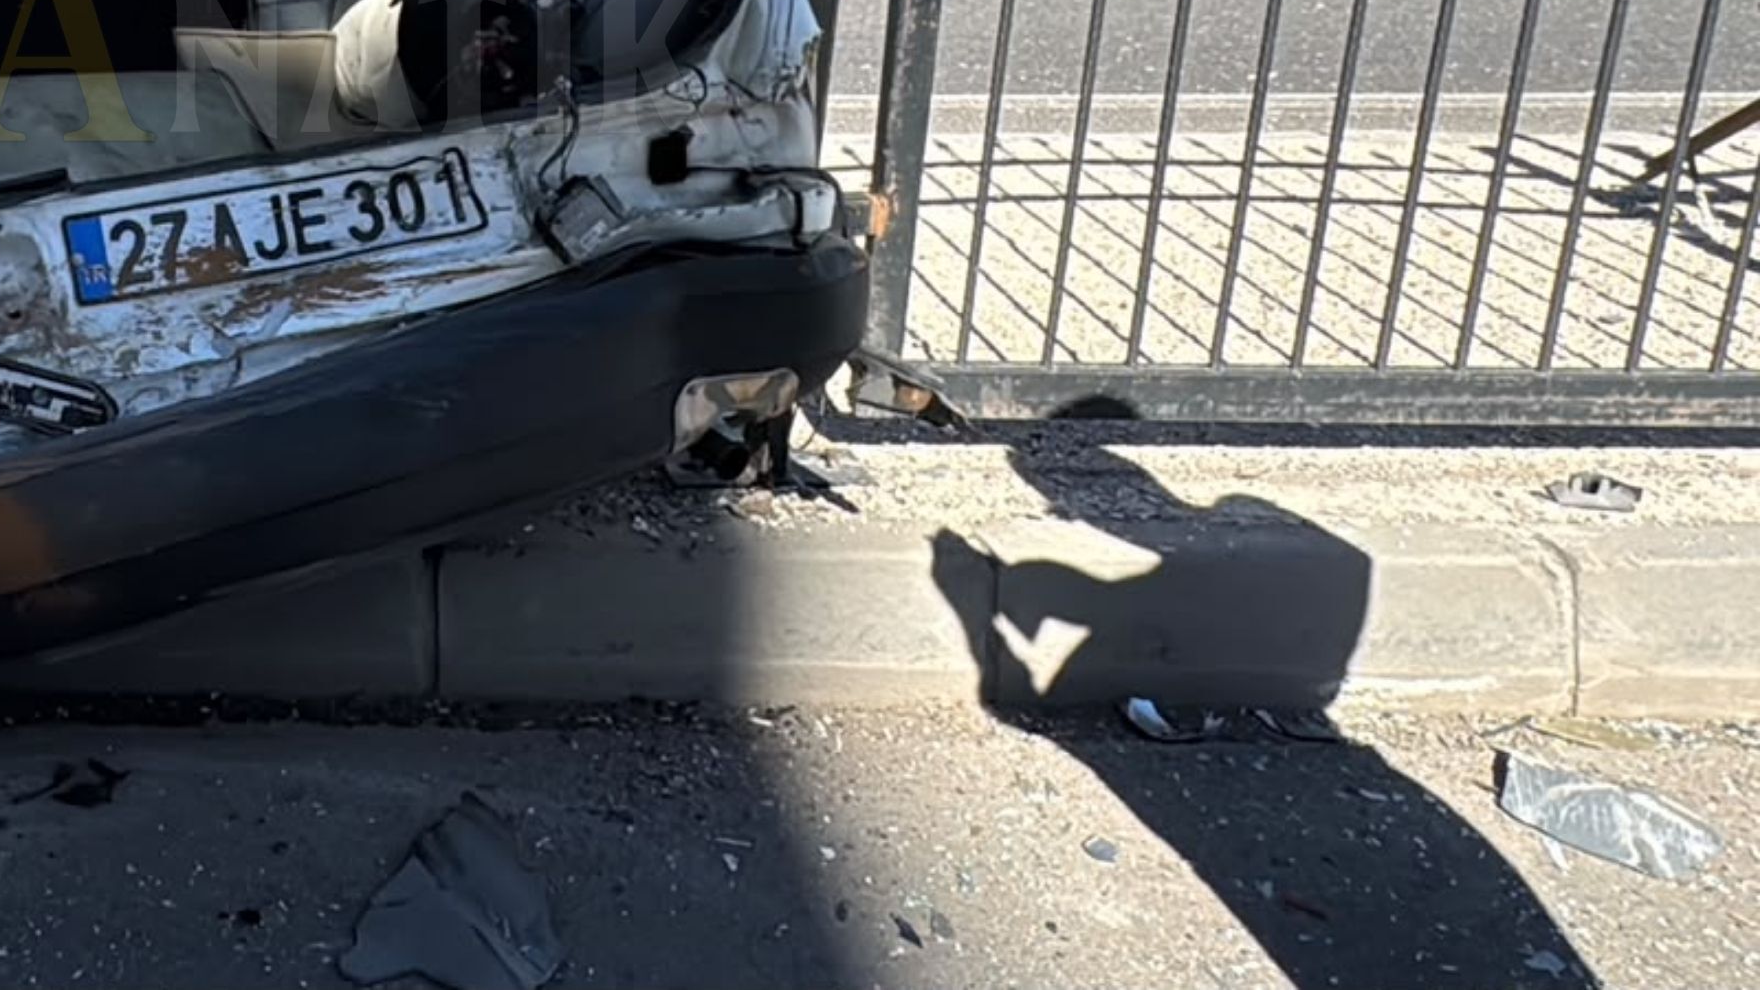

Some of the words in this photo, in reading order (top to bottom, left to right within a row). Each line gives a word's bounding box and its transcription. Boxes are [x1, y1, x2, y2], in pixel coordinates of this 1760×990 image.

[109, 210, 188, 293] 27
[213, 189, 333, 268] AJE
[344, 159, 469, 244] 301
